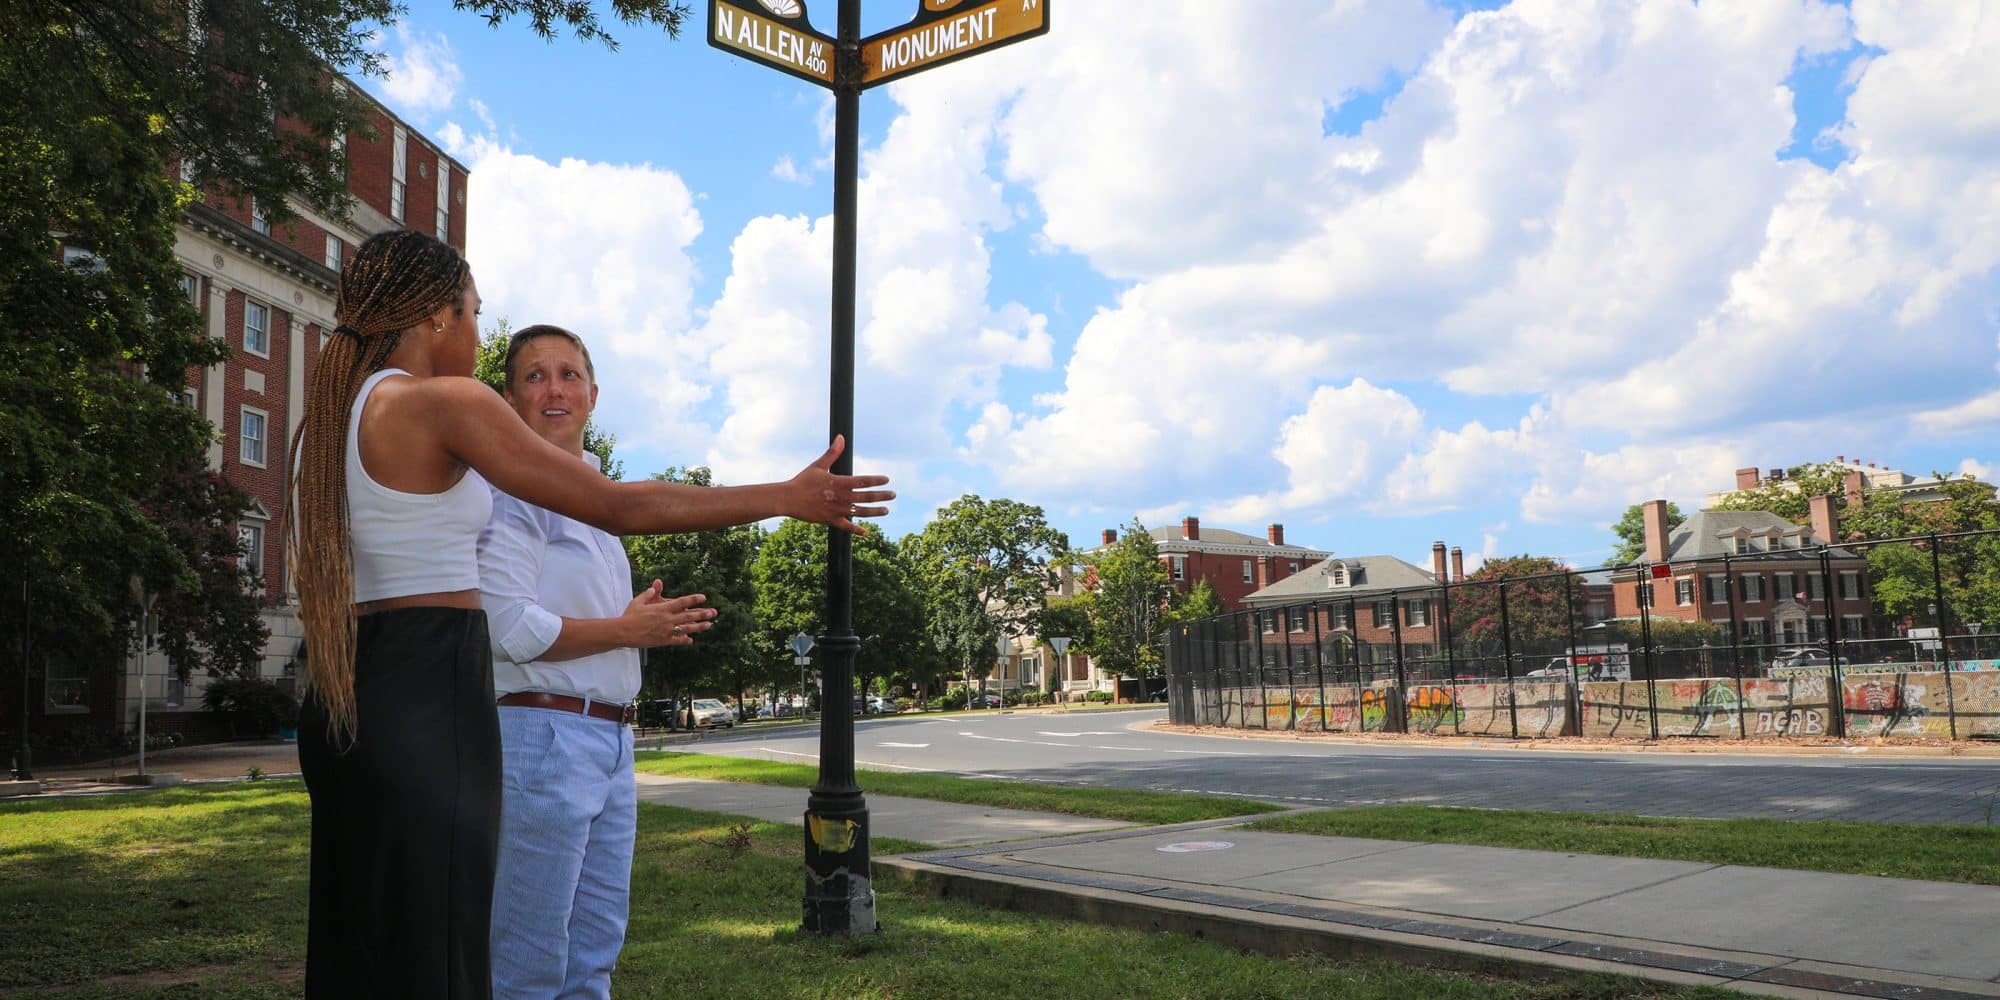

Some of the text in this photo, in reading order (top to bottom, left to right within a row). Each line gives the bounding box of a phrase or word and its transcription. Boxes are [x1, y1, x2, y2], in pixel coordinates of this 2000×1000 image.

[718, 6, 804, 67] N ALLEN
[809, 41, 823, 58] AV
[881, 7, 997, 73] MONUMENT
[805, 56, 827, 75] 400
[1754, 708, 1824, 736] ACAB
